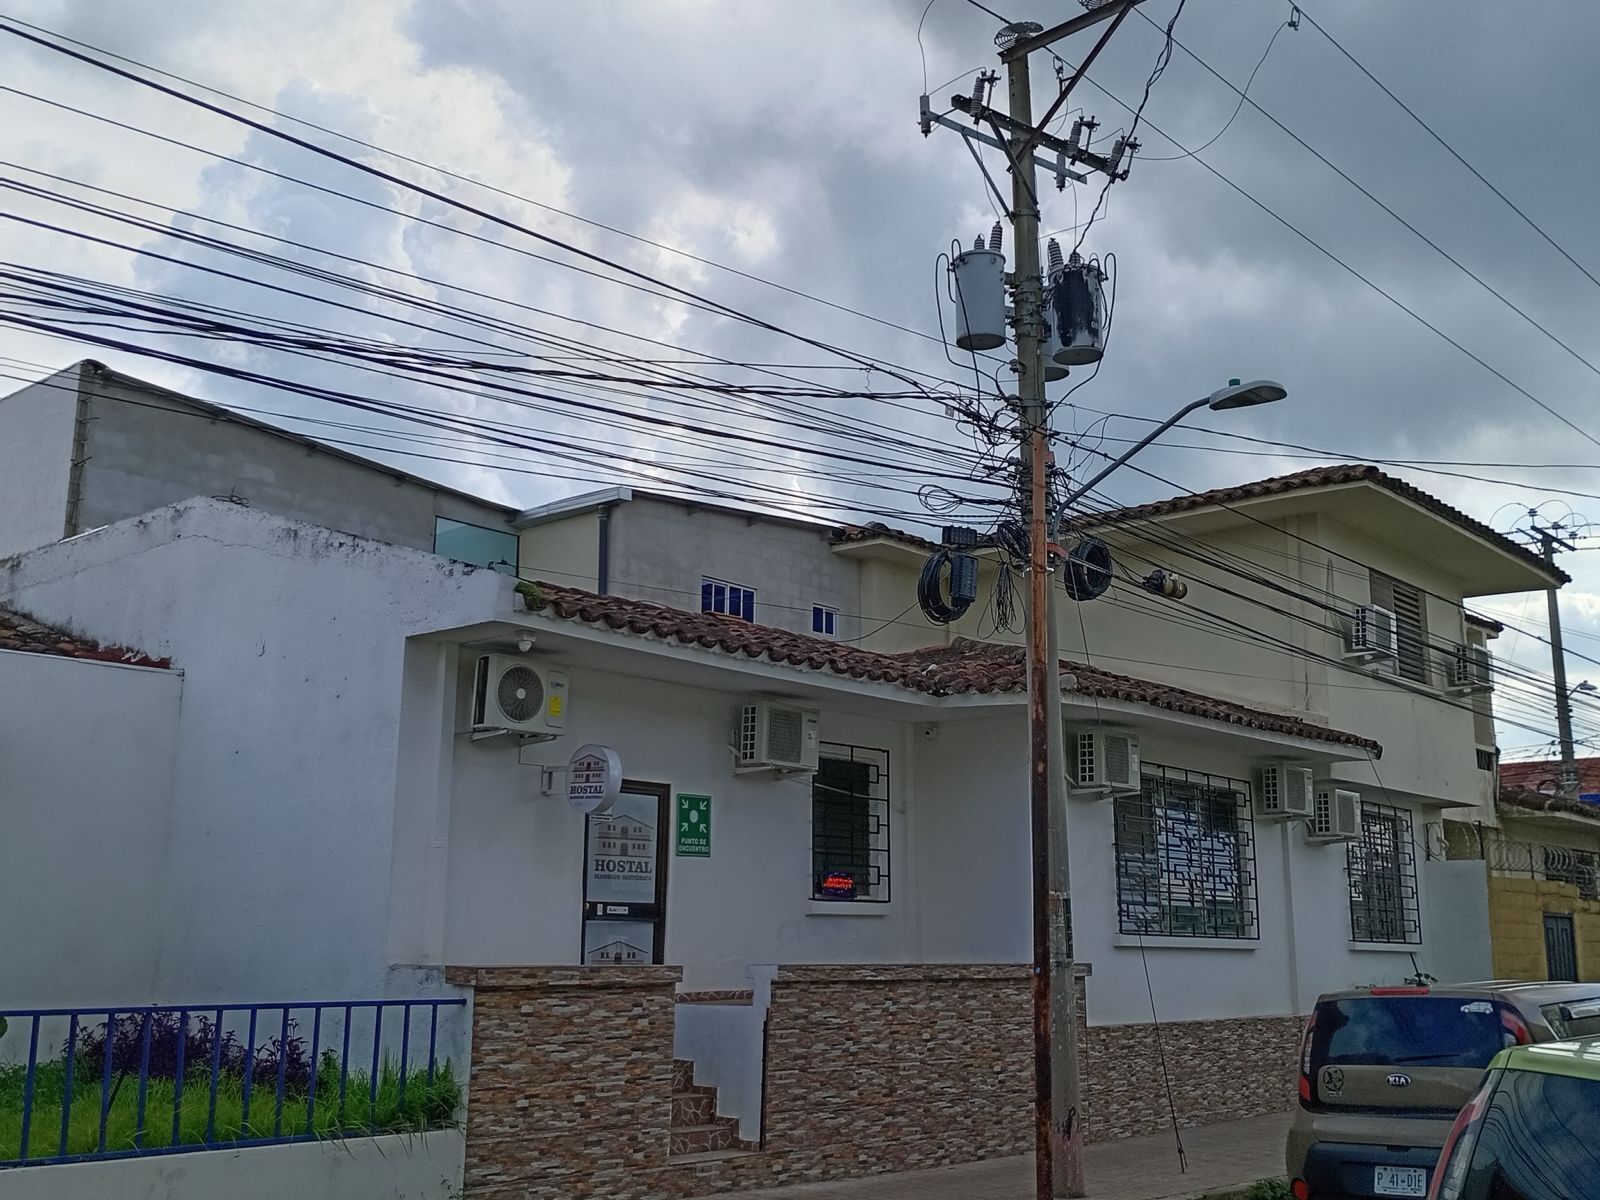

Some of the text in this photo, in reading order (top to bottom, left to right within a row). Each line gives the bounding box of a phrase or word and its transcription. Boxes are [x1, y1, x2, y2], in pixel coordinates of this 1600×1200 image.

[569, 785, 604, 795] HOSTAL
[681, 837, 698, 845] PUNTO
[678, 844, 710, 853] ENCUENTRO
[594, 859, 653, 873] HOSTAL
[1389, 1076, 1406, 1085] KIA
[1377, 1172, 1384, 1186] P
